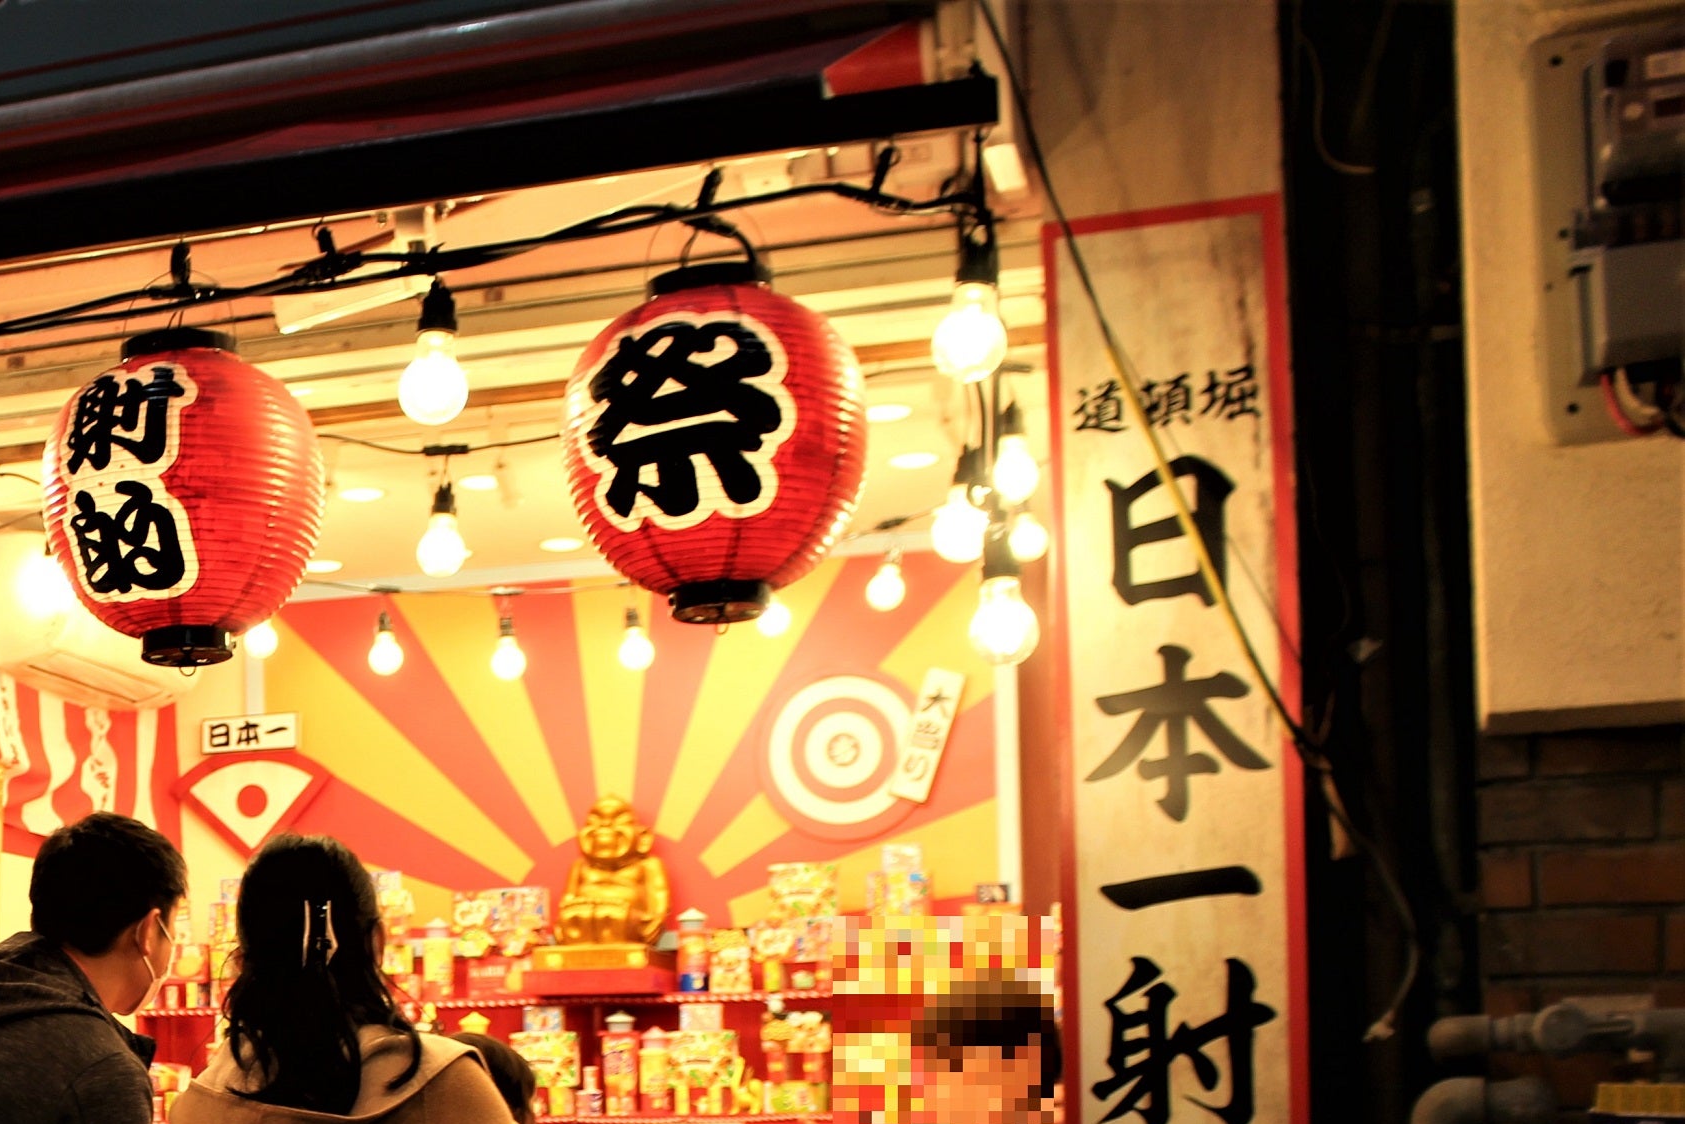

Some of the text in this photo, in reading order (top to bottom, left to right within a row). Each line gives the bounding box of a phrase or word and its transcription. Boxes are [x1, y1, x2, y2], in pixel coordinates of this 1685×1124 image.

[587, 320, 782, 518] 祭
[1072, 364, 1261, 434] 道頓堀
[67, 368, 188, 597] 射的
[208, 720, 289, 750] 日本一
